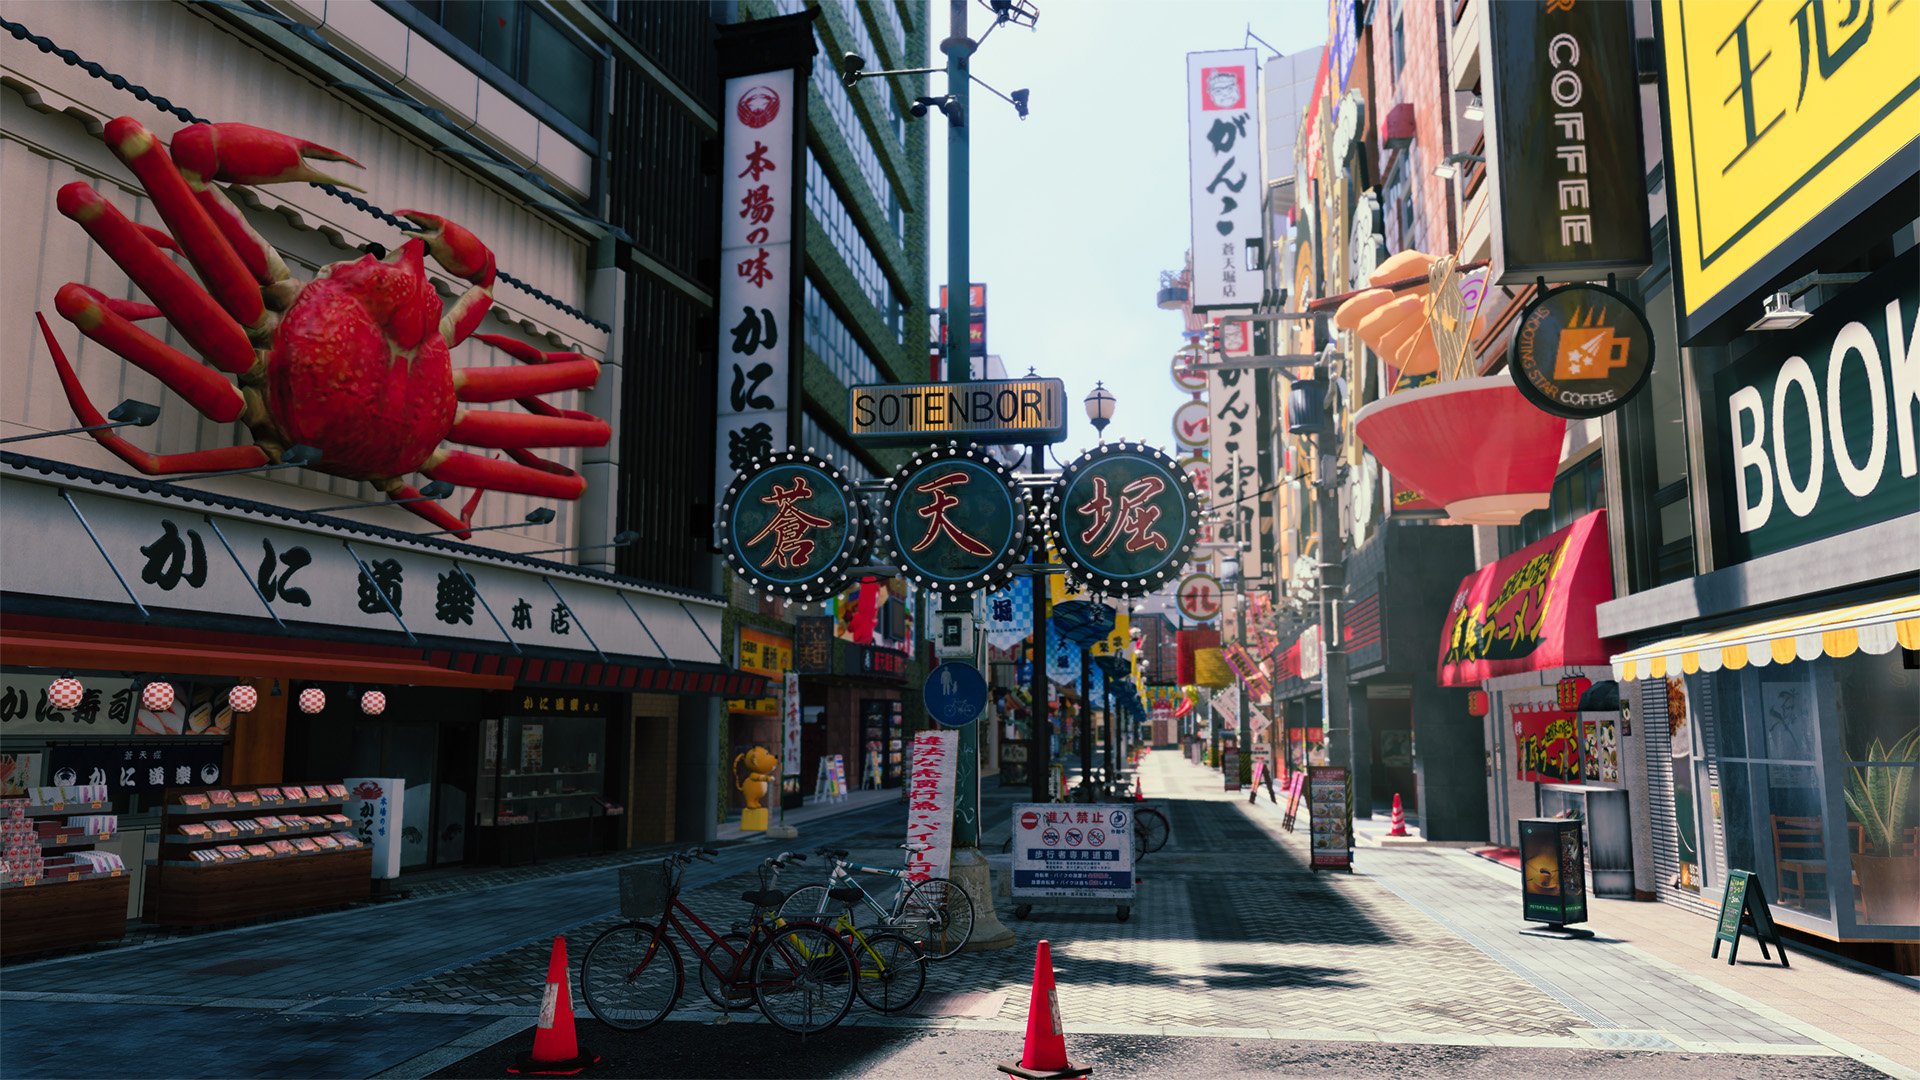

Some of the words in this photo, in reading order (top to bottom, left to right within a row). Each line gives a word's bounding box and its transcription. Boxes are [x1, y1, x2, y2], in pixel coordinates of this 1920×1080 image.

[1548, 33, 1592, 247] COFFEE
[1206, 112, 1250, 236] がんこ
[738, 141, 776, 289] 本場の味
[1222, 243, 1237, 298] 蒼天堀店
[1519, 305, 1551, 369] SHOOTING
[854, 387, 1053, 428] SOTENBORI
[1528, 369, 1559, 399] STAR
[1560, 389, 1617, 407] COFFEE
[1729, 298, 1920, 534] BOOK
[747, 471, 1168, 569] 蒼天堀
[1045, 811, 1104, 824] 進入禁止
[1035, 851, 1113, 860] 歩行者専用道路
